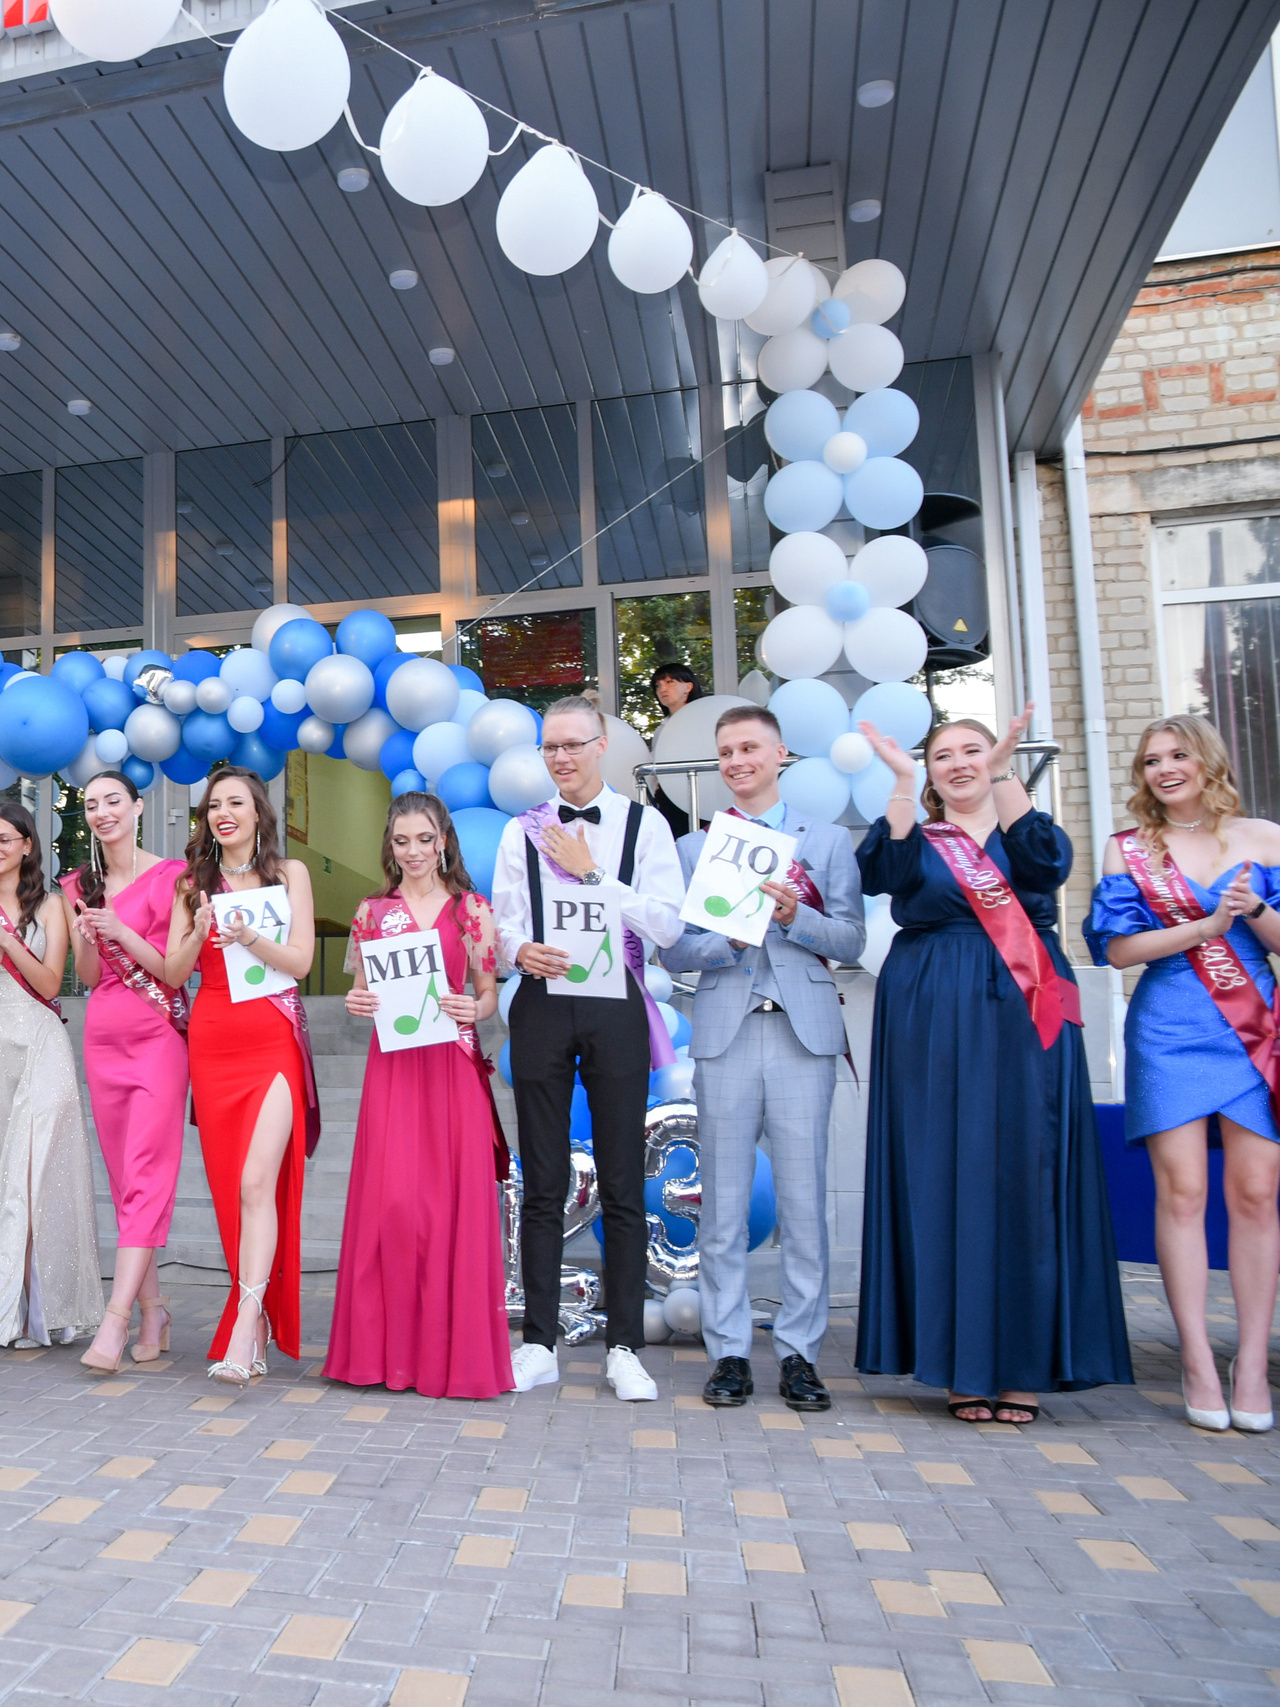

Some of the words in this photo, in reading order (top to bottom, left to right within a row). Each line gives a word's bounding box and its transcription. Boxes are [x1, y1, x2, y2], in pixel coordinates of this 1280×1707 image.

[709, 834, 778, 873] ДО
[956, 870, 1012, 909] 2023
[224, 901, 286, 929] ФА
[552, 900, 607, 932] РЕ
[365, 944, 441, 984] МИ
[1194, 945, 1248, 990] 2023
[458, 1023, 479, 1051] 023
